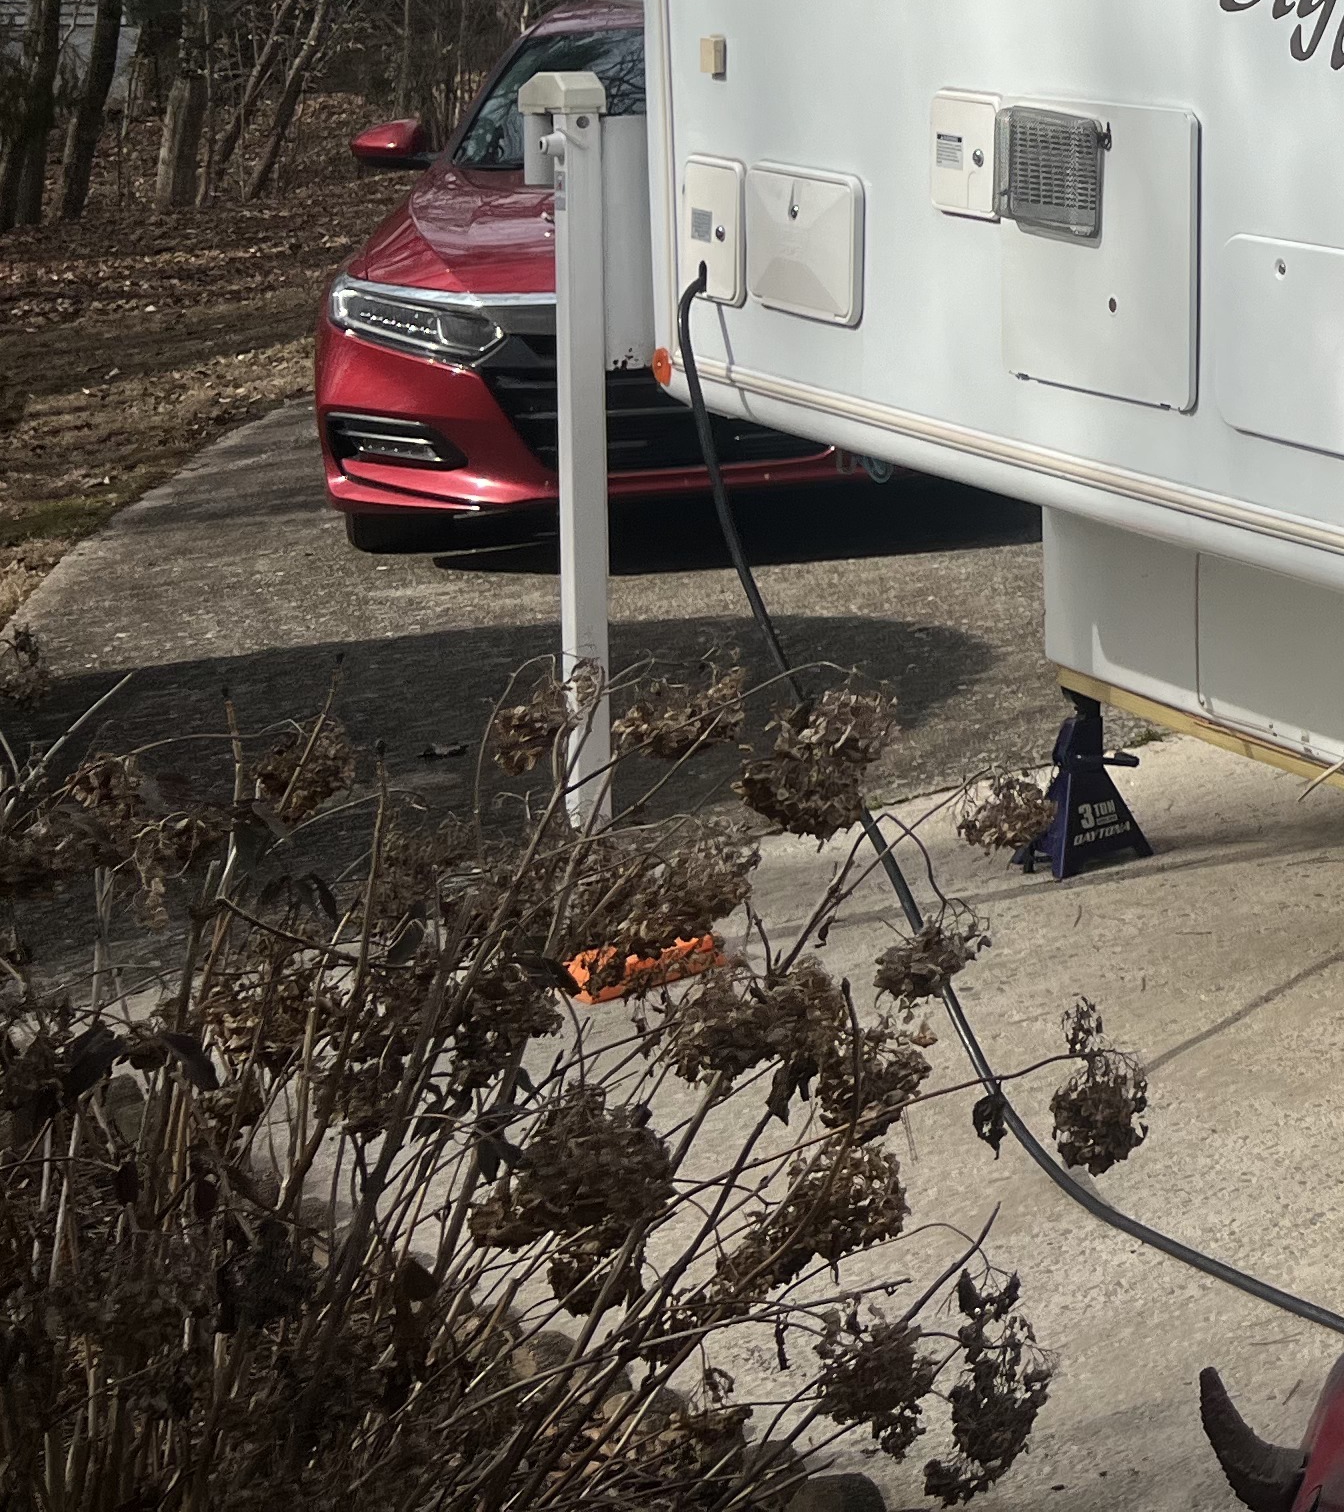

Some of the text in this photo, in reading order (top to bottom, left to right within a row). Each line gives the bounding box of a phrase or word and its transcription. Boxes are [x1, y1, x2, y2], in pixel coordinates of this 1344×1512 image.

[1078, 803, 1095, 829] 3
[1093, 799, 1116, 817] TON
[1073, 820, 1131, 846] DAYTONA
